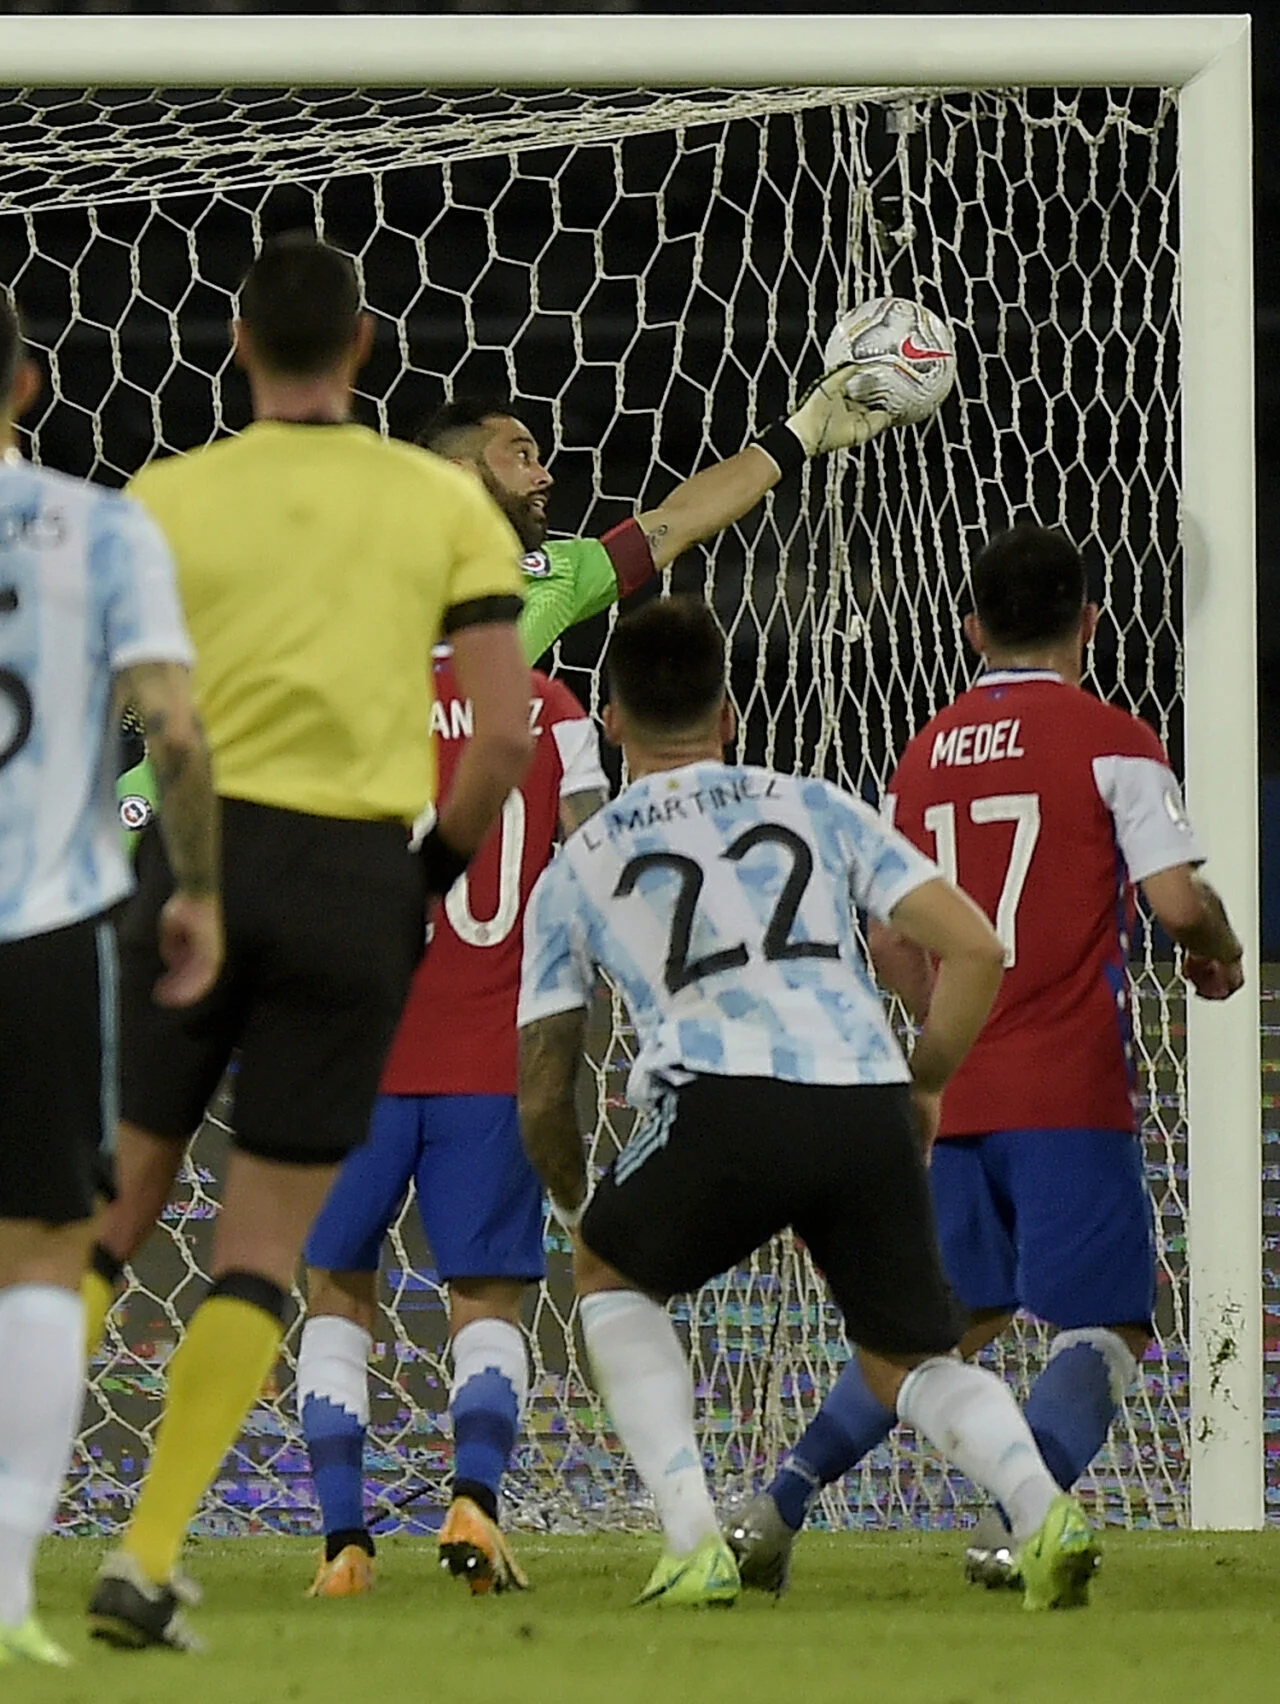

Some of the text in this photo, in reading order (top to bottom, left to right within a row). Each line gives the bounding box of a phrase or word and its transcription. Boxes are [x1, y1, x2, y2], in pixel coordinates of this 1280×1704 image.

[930, 718, 1025, 769] MEDEL
[611, 822, 841, 995] 22
[924, 793, 1041, 968] 17
